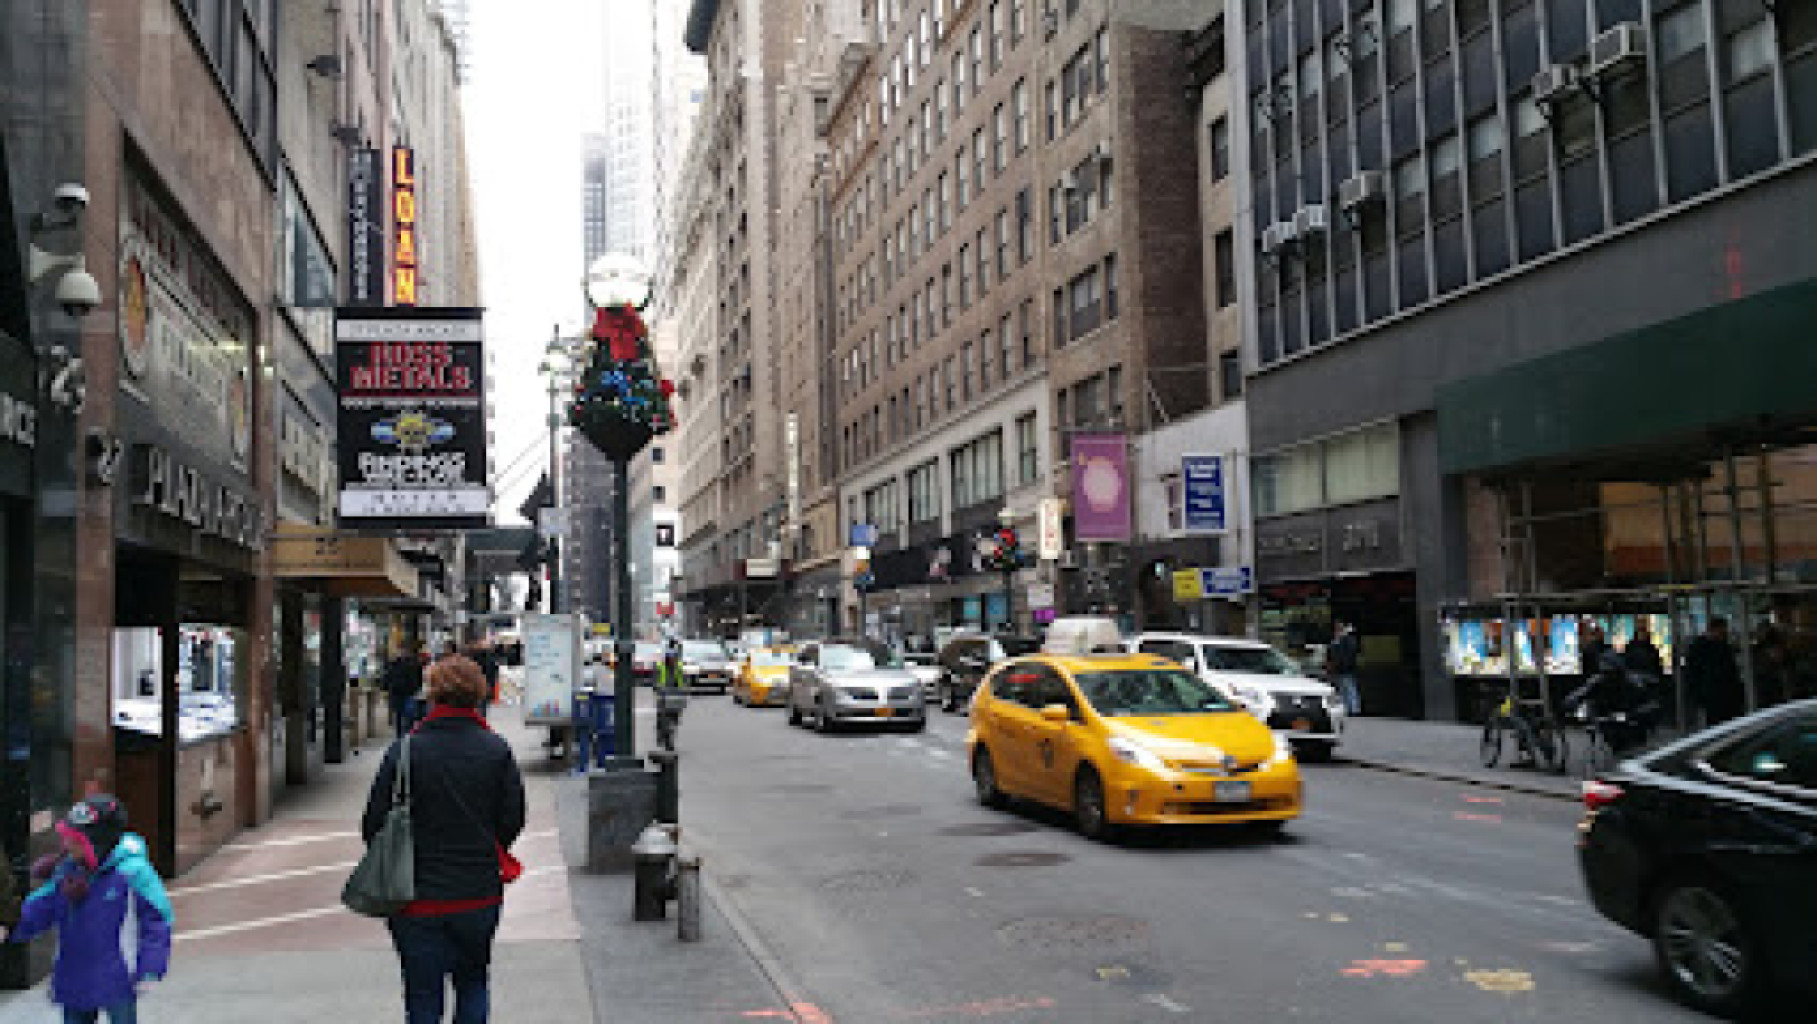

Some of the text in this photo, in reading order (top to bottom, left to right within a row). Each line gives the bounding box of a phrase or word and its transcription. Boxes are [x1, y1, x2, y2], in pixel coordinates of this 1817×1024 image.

[395, 148, 415, 304] LOAN
[370, 341, 453, 365] ROSS
[349, 365, 473, 390] METALS
